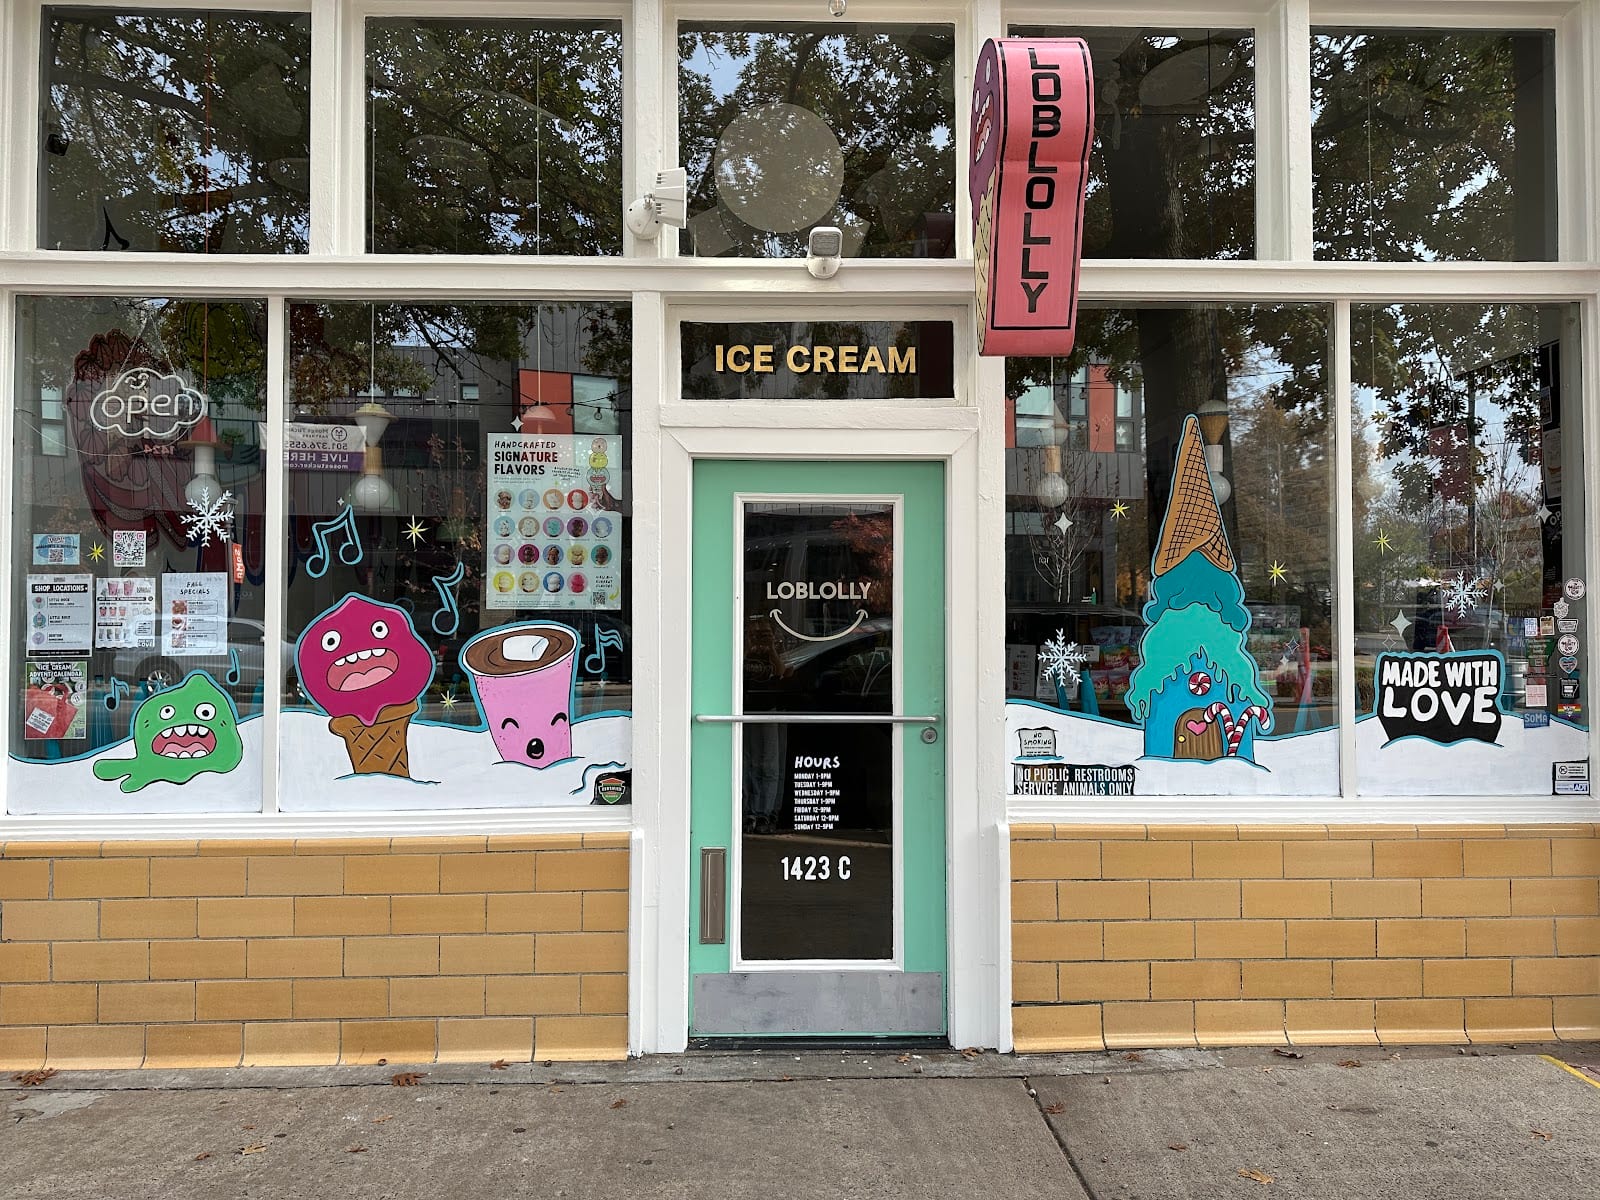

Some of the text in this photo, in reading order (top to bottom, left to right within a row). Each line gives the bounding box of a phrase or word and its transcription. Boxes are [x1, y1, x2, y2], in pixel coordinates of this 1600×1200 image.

[1020, 47, 1061, 313] LOBLOLLY
[715, 344, 917, 374] ICE CREAM
[101, 393, 193, 424] open
[494, 440, 557, 449] HANDCRAFTED
[494, 451, 558, 463] SIGNATURE
[494, 463, 545, 475] FLAVORS
[34, 584, 85, 592] SHOP LOCATIONS
[766, 582, 871, 600] LOBLOLLY
[1382, 660, 1497, 688] MADE WITH
[1383, 686, 1498, 725] LOVE
[794, 756, 840, 769] HOURS
[1017, 768, 1133, 781] NO PUBLIC RESTROOMS
[1017, 782, 1133, 795] SERVICE ANIMALS ONLY
[781, 855, 851, 880] 1423 C
